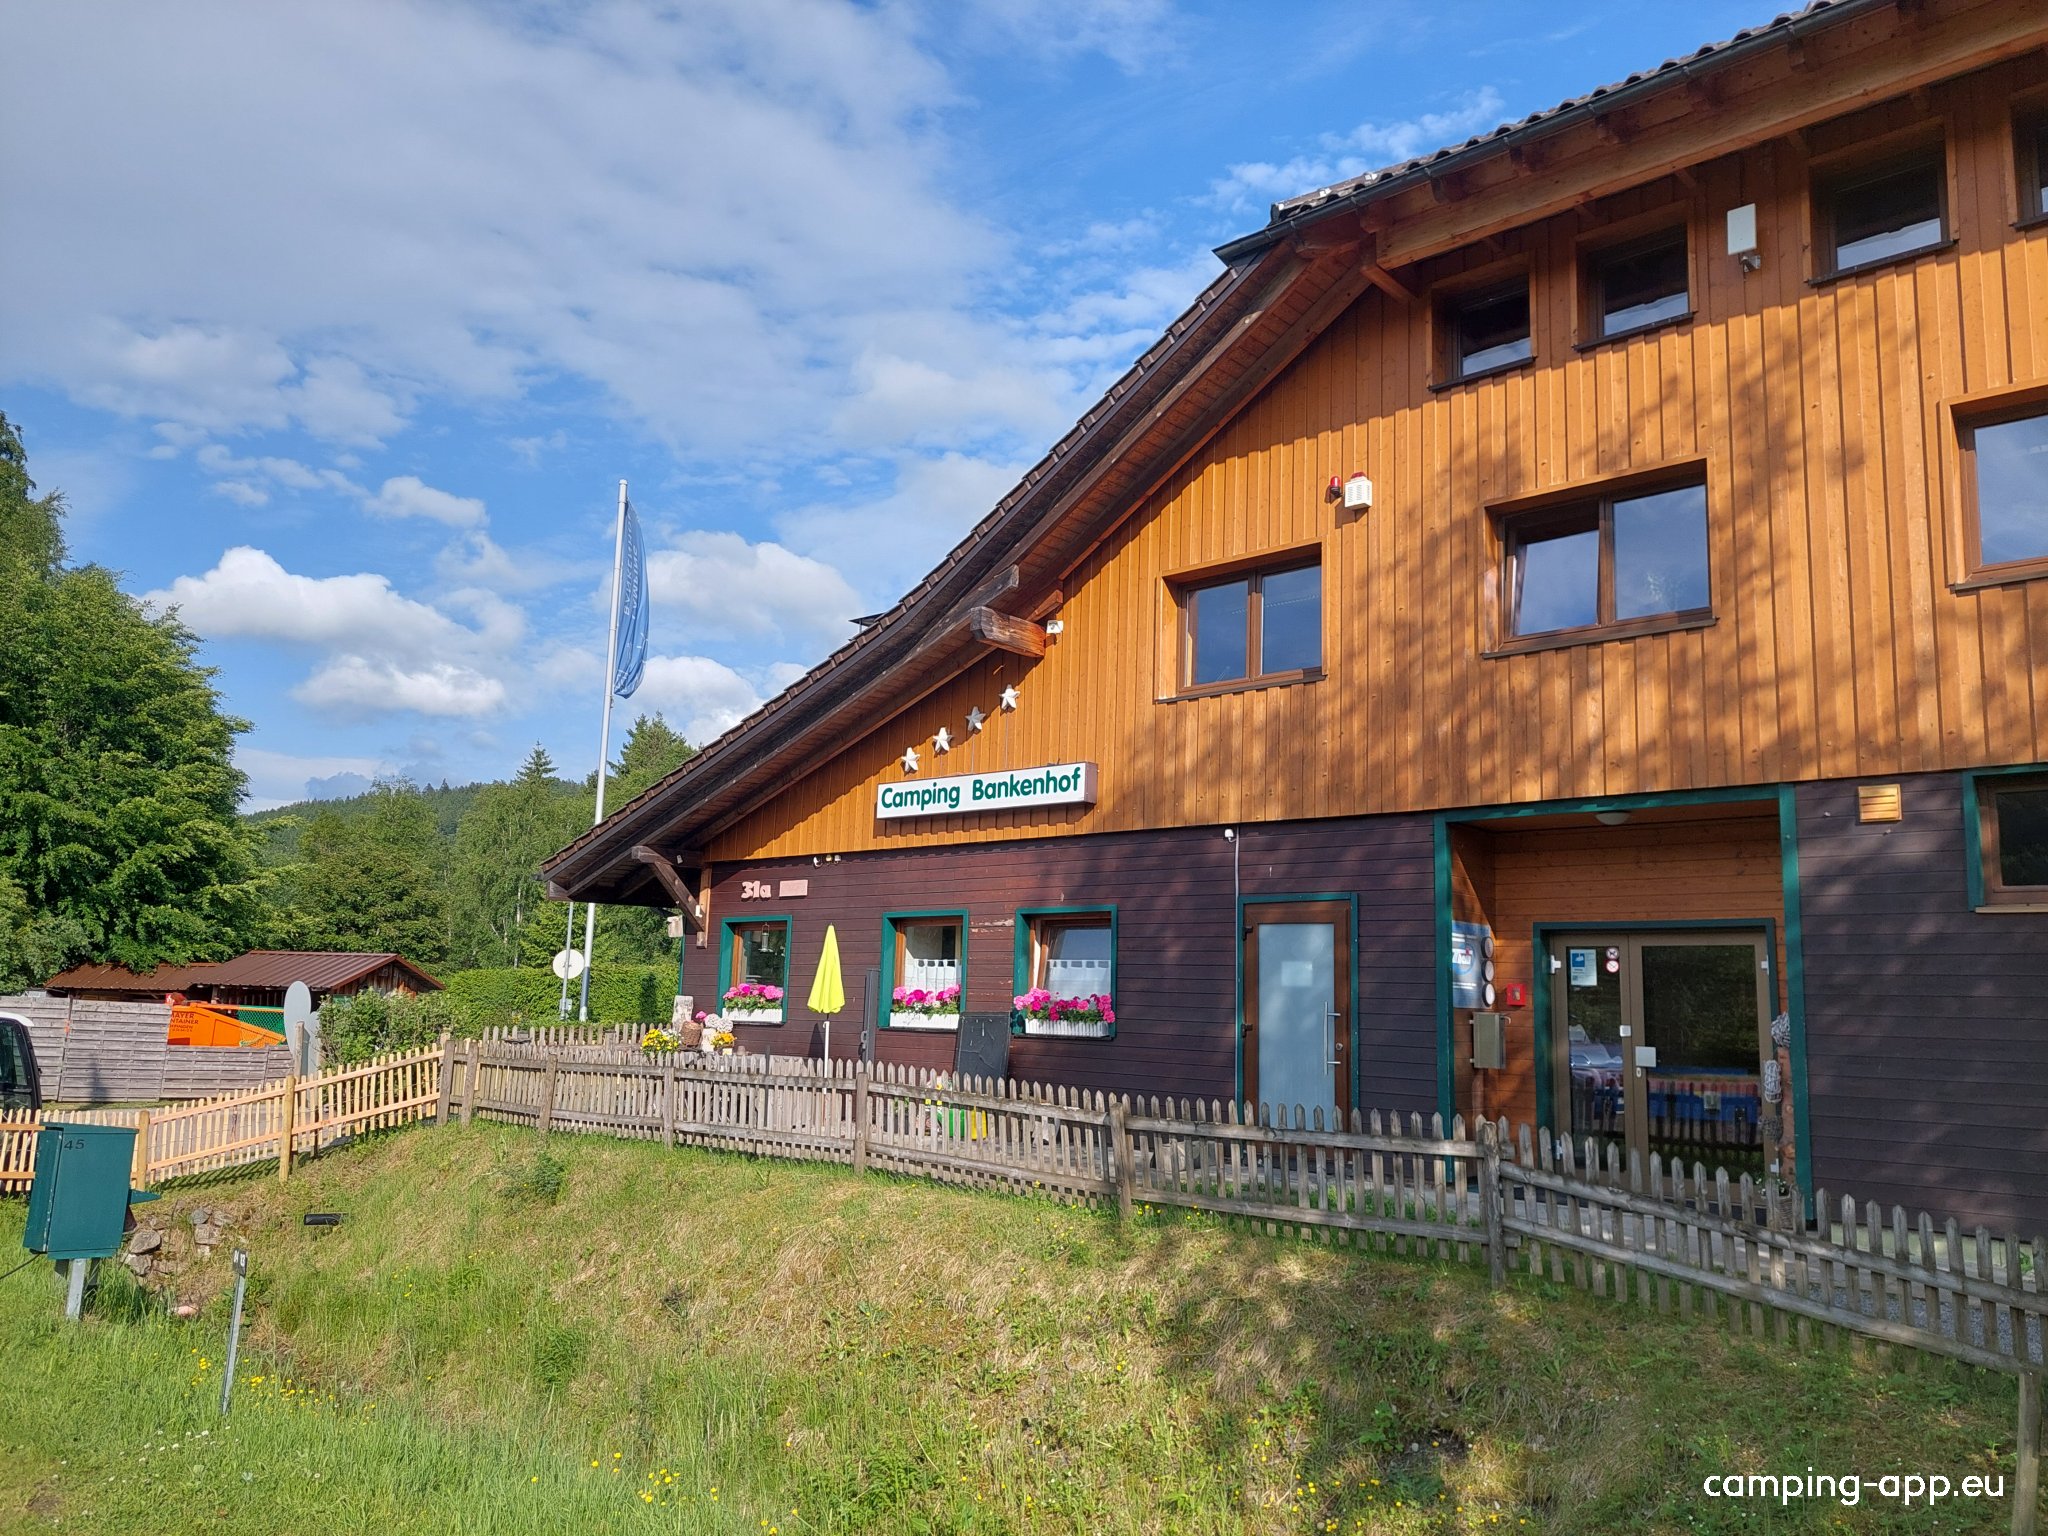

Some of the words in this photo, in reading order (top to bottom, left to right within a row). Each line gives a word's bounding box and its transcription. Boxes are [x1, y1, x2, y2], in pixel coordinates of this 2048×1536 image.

[881, 782, 961, 811] Camping
[972, 767, 1081, 800] Bankenhof
[741, 881, 771, 899] 31a
[64, 1139, 85, 1150] 45
